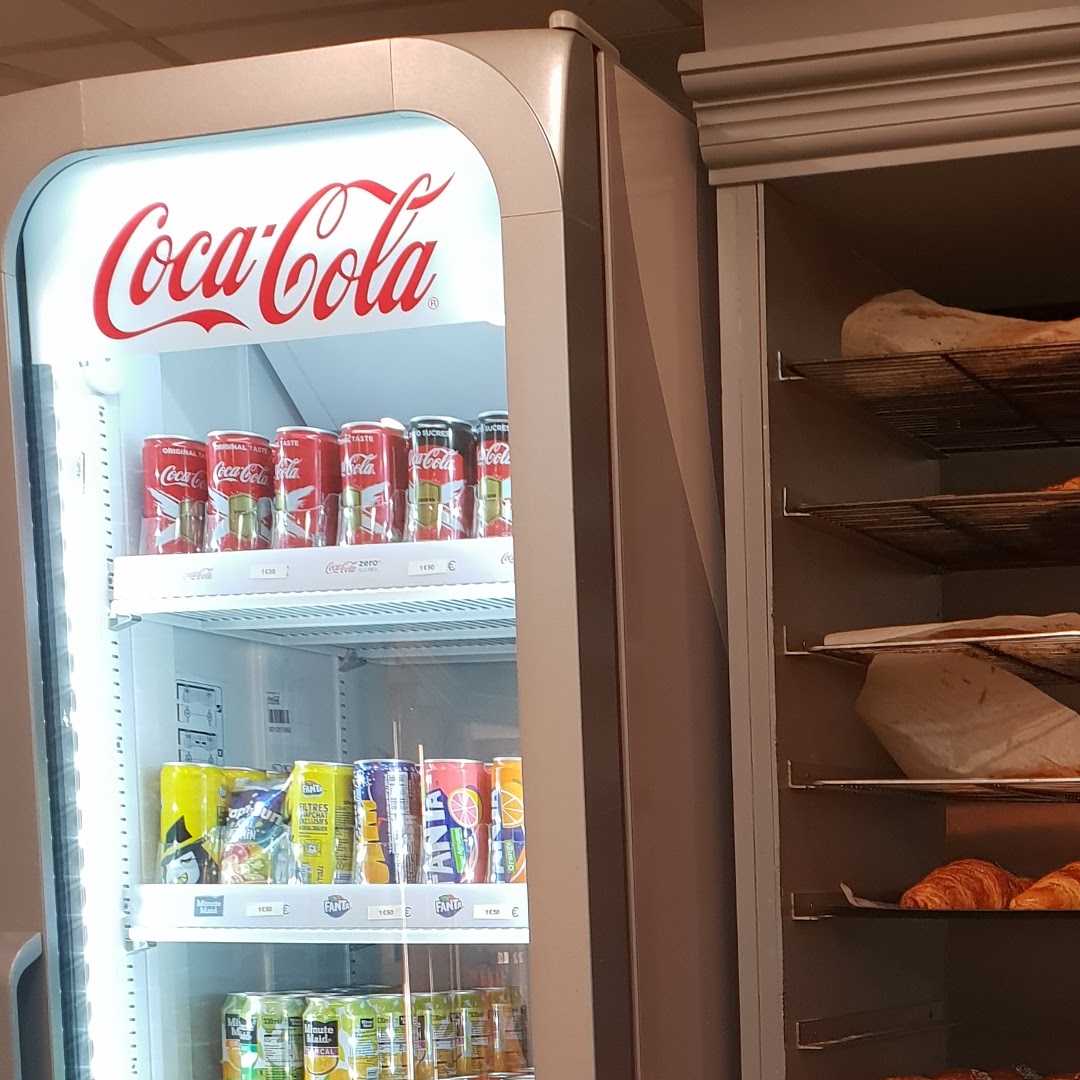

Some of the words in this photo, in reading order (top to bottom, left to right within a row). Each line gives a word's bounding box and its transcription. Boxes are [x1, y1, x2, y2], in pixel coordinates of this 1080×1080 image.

[93, 172, 456, 340] Coca-Cola
[212, 461, 269, 489] Coca-Cola
[323, 900, 351, 913] FANTA
[435, 898, 464, 914] FANTA
